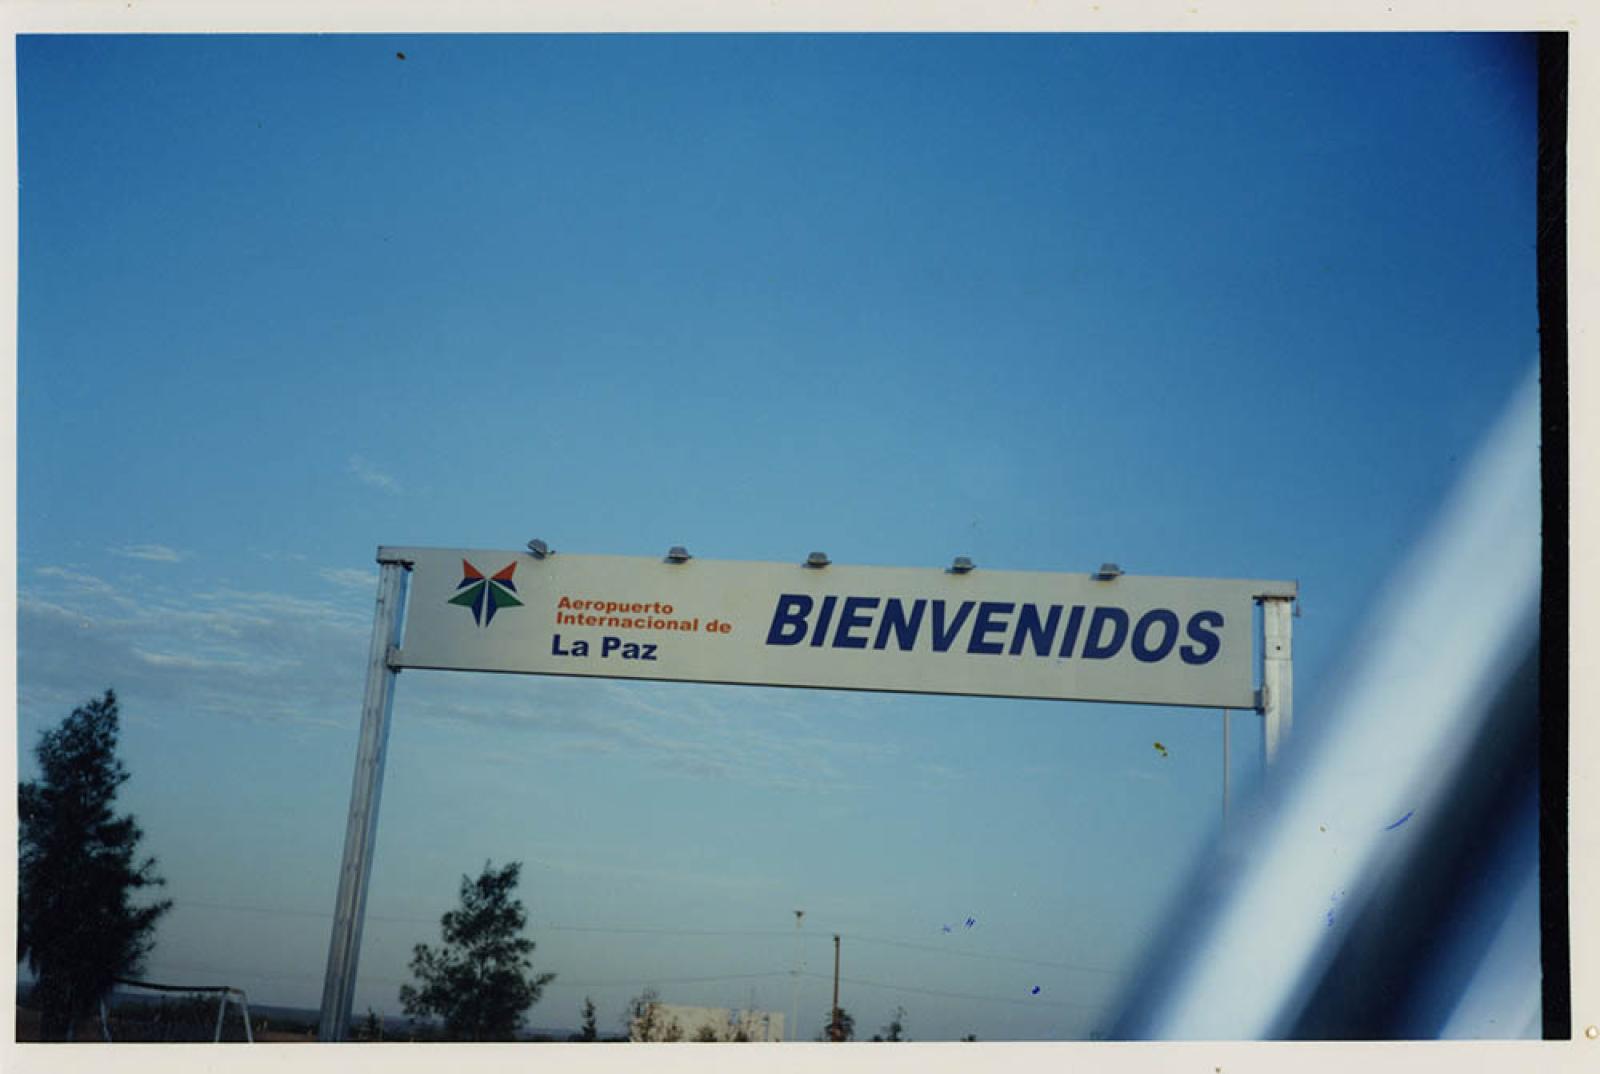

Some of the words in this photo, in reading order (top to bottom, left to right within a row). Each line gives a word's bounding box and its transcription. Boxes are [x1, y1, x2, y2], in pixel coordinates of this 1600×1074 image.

[557, 596, 674, 615] Aeropuerto
[556, 611, 699, 632] Internacional
[705, 619, 732, 634] de
[766, 593, 1224, 665] BIENVENIDOS
[551, 634, 589, 657] La
[601, 636, 657, 661] Paz
